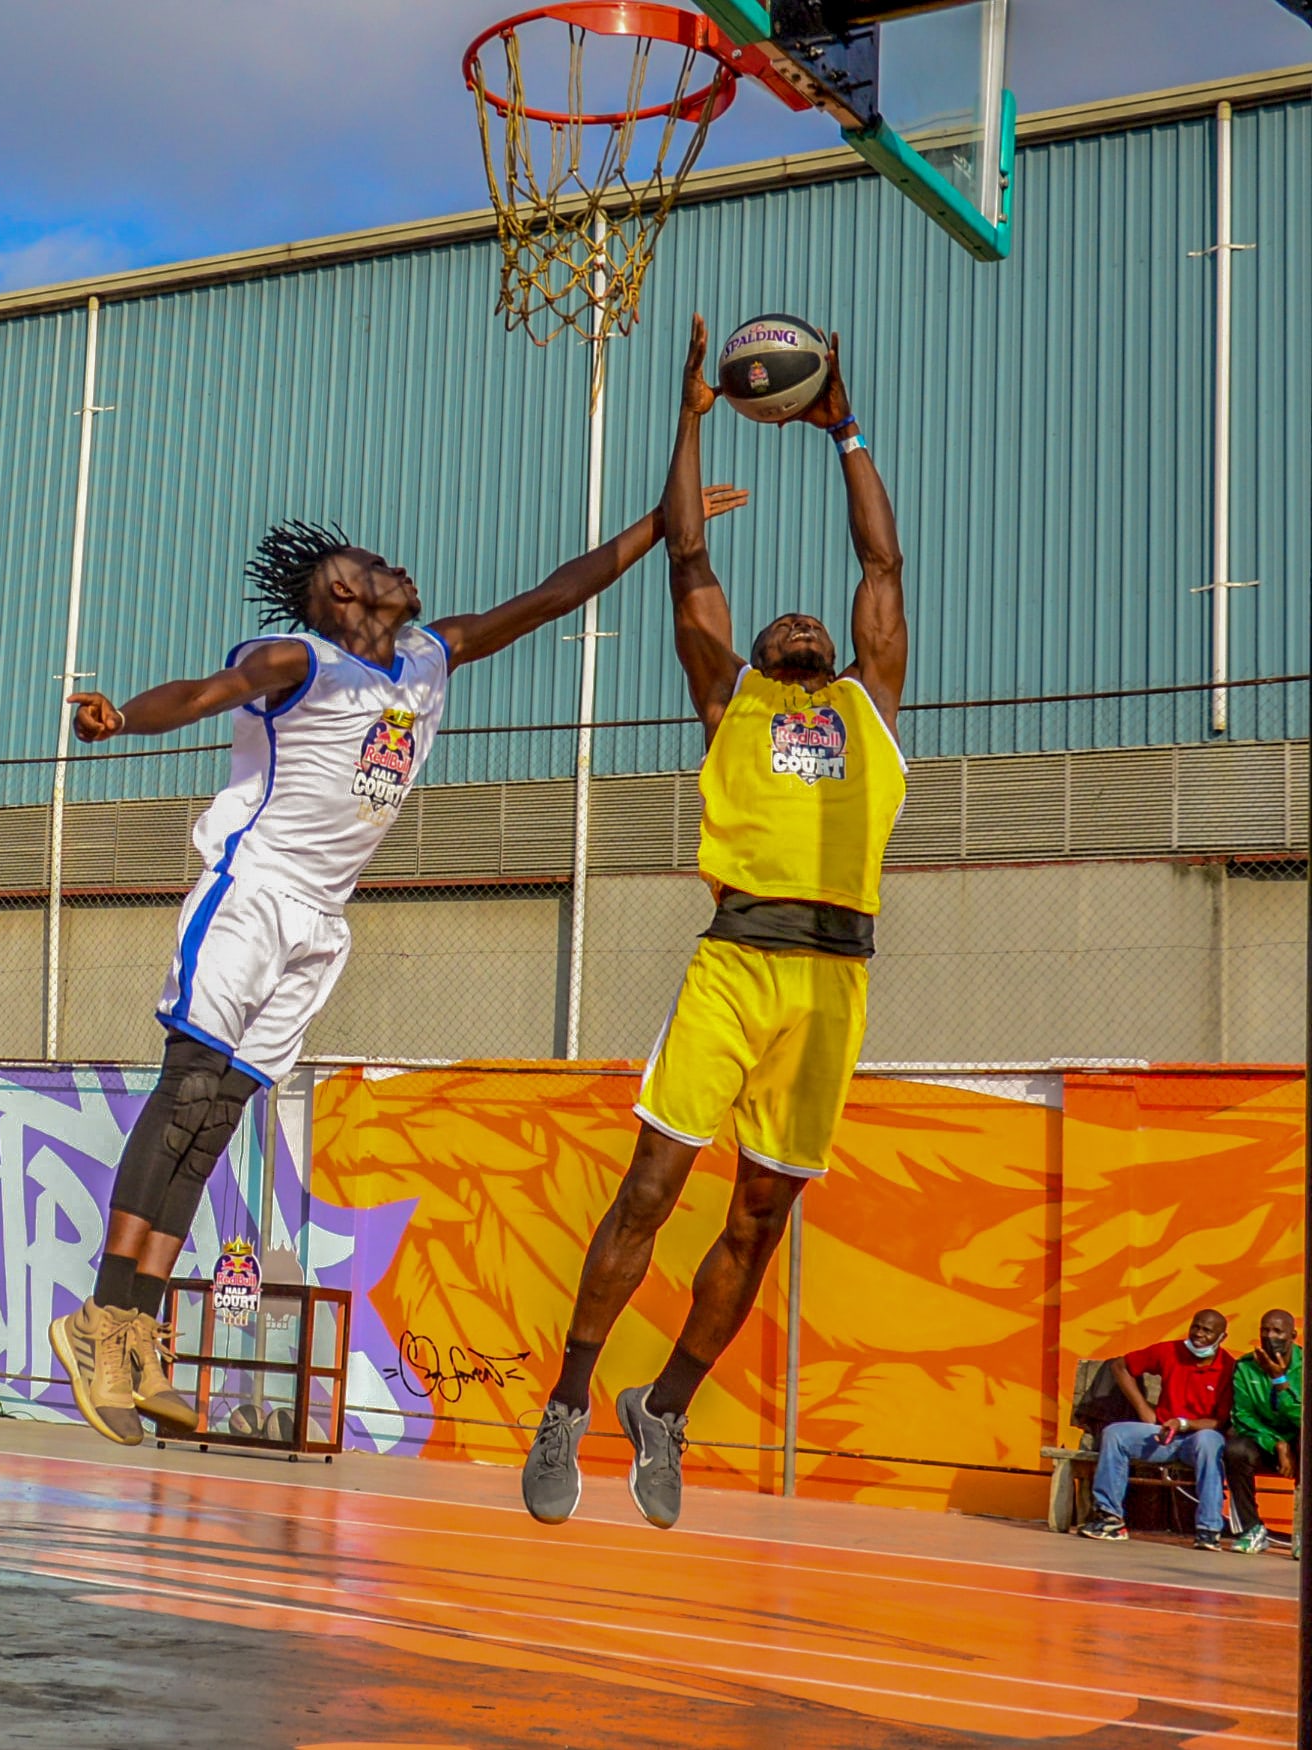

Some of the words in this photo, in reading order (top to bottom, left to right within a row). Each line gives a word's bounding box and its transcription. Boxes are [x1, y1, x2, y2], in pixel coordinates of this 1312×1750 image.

[725, 329, 798, 359] SPALDING
[777, 726, 808, 744] Red
[809, 730, 840, 747] Bull
[365, 745, 388, 765] Red
[792, 747, 825, 757] HALF
[773, 752, 843, 778] COURT
[371, 767, 397, 783] HALF
[353, 771, 404, 806] COURT
[216, 1272, 235, 1285] Red
[236, 1274, 257, 1286] Bull
[225, 1286, 247, 1294] HALF
[214, 1292, 257, 1309] COURT
